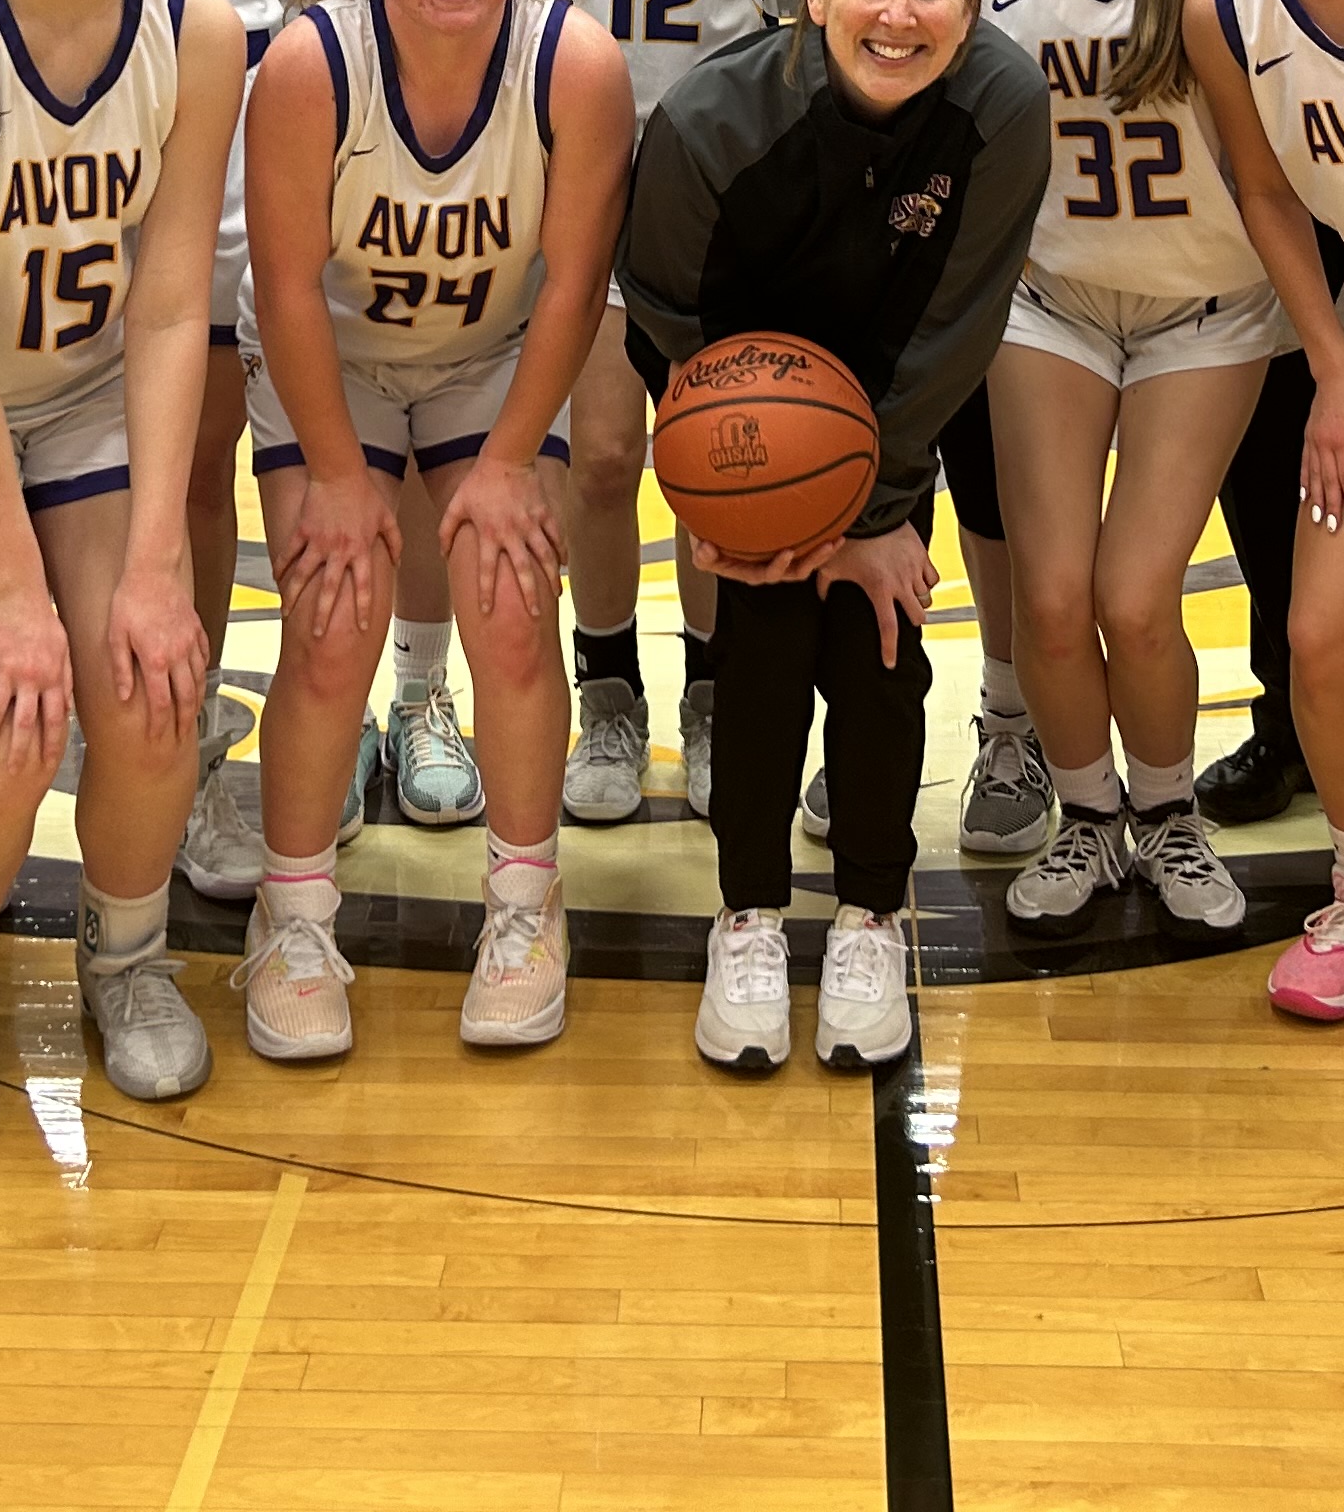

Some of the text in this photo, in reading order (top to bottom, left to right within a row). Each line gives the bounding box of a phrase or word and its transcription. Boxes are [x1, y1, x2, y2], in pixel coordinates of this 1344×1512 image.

[1055, 117, 1192, 221] 32
[358, 195, 511, 259] AVON
[18, 242, 118, 352] 15
[364, 267, 497, 328] 24
[672, 344, 812, 401] Rawlings
[709, 445, 768, 472] OHSAA
